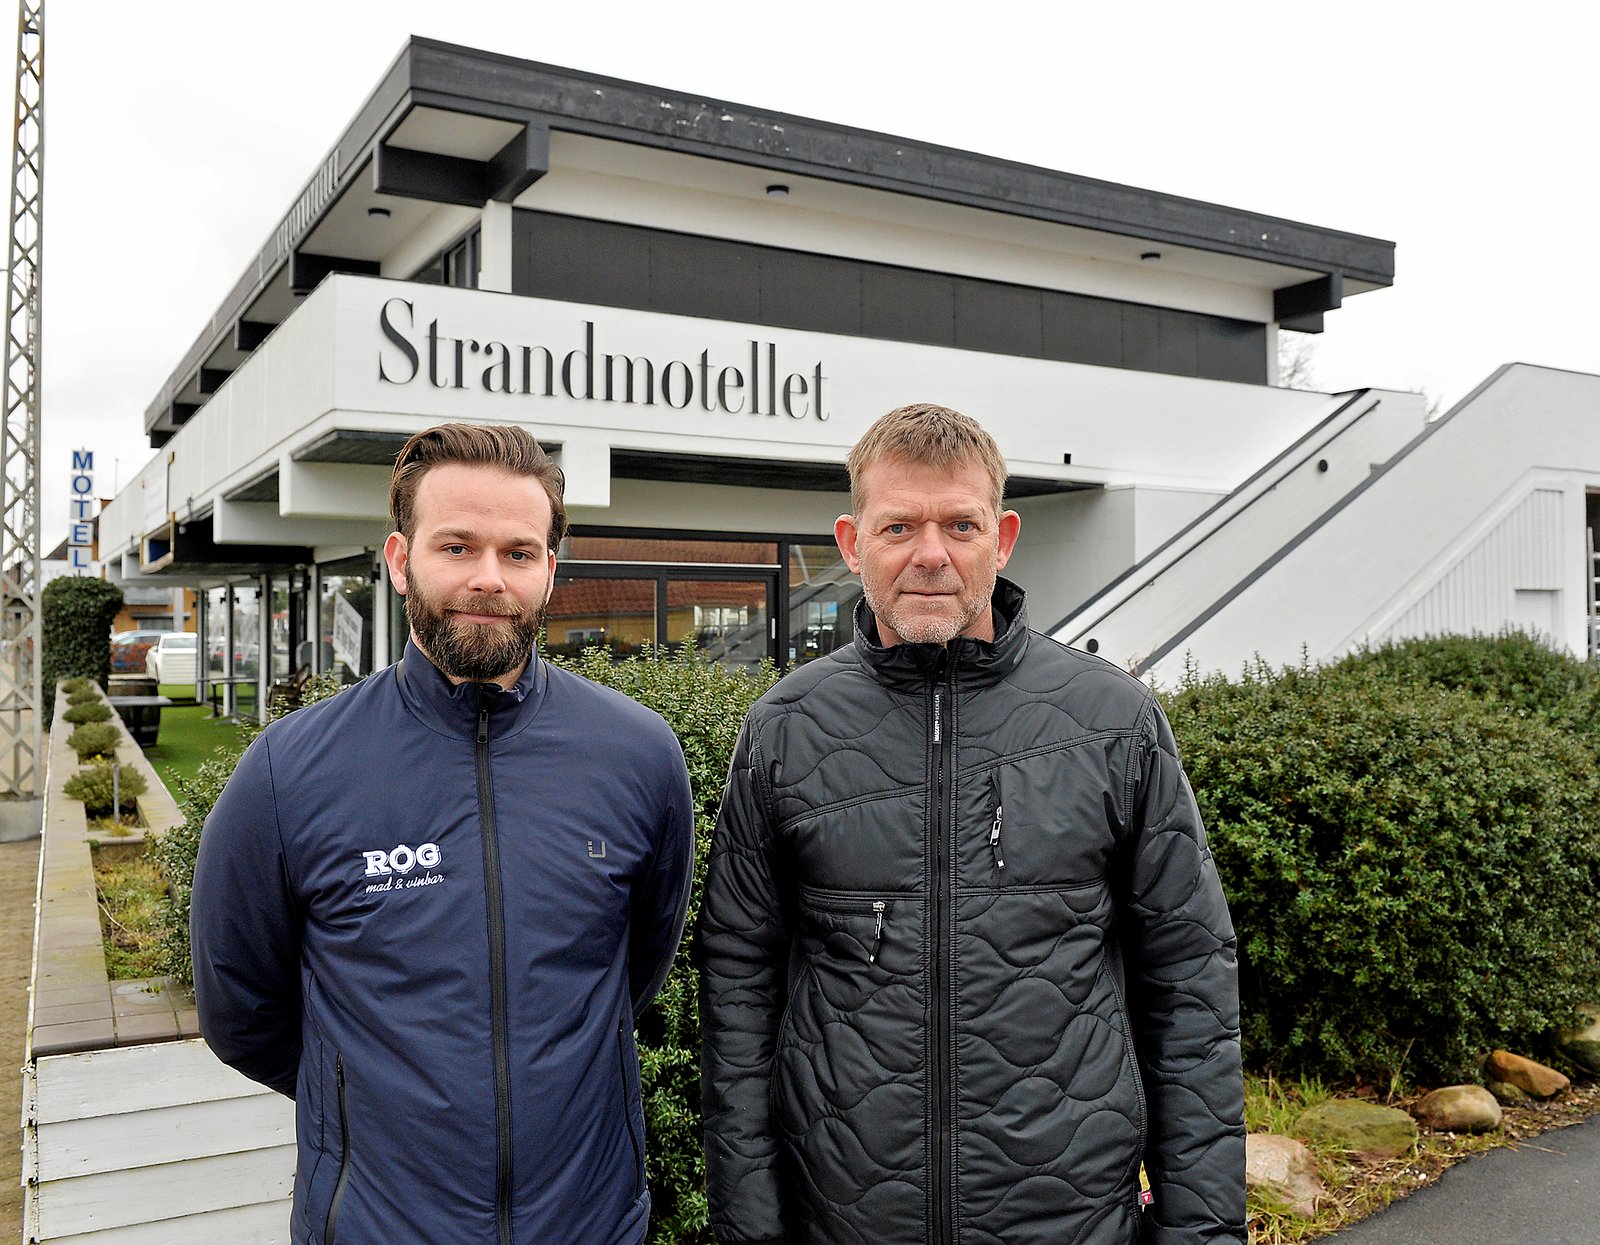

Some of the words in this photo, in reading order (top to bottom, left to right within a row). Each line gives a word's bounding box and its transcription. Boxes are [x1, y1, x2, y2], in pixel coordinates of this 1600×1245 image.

[378, 297, 830, 422] Strandmotellet
[73, 451, 93, 568] MOTEL
[365, 876, 393, 893] mad
[395, 878, 404, 890] &
[405, 871, 444, 889] vinbar
